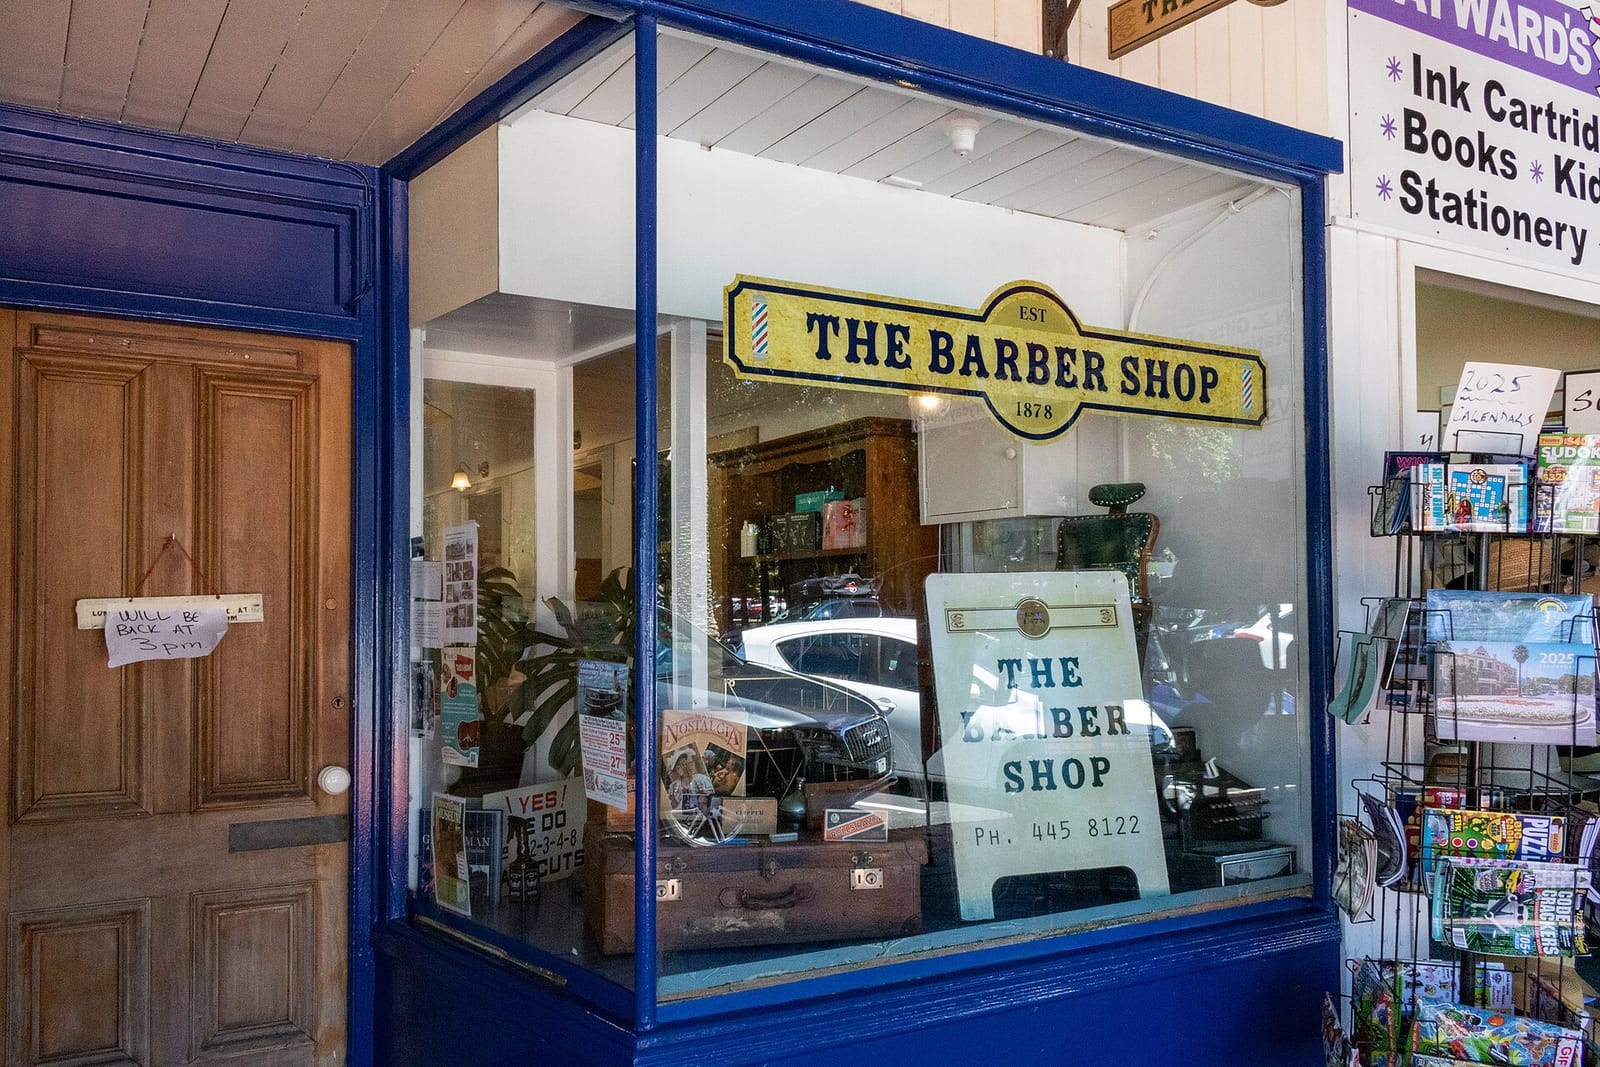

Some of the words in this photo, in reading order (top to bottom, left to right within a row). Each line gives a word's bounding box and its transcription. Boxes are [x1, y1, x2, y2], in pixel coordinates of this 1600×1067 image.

[1142, 0, 1193, 24] TH
[1412, 53, 1471, 113] Ink
[1483, 79, 1600, 154] Cartrid
[1404, 107, 1518, 180] Books
[1398, 169, 1588, 266] Stationery
[1019, 306, 1047, 323] EST
[807, 311, 913, 370] THE
[928, 329, 1109, 393] BARBER
[1120, 355, 1220, 405] SHOP
[1463, 370, 1532, 393] 2025
[1015, 401, 1053, 420] 1878
[1572, 389, 1600, 412] S
[116, 623, 160, 636] BACK
[172, 624, 194, 635] AT
[119, 610, 171, 623] WILL
[183, 611, 199, 623] BE
[1539, 652, 1575, 665] 2025
[997, 656, 1083, 689] THE
[666, 719, 740, 745] NOSTALGIA
[1003, 756, 1111, 793] SHOP
[542, 810, 566, 832] DO
[975, 826, 1012, 846] PH.
[1033, 820, 1071, 841] 445
[1088, 815, 1141, 837] 8122
[1556, 890, 1573, 923] CODE
[1540, 889, 1559, 956] CRACKERS
